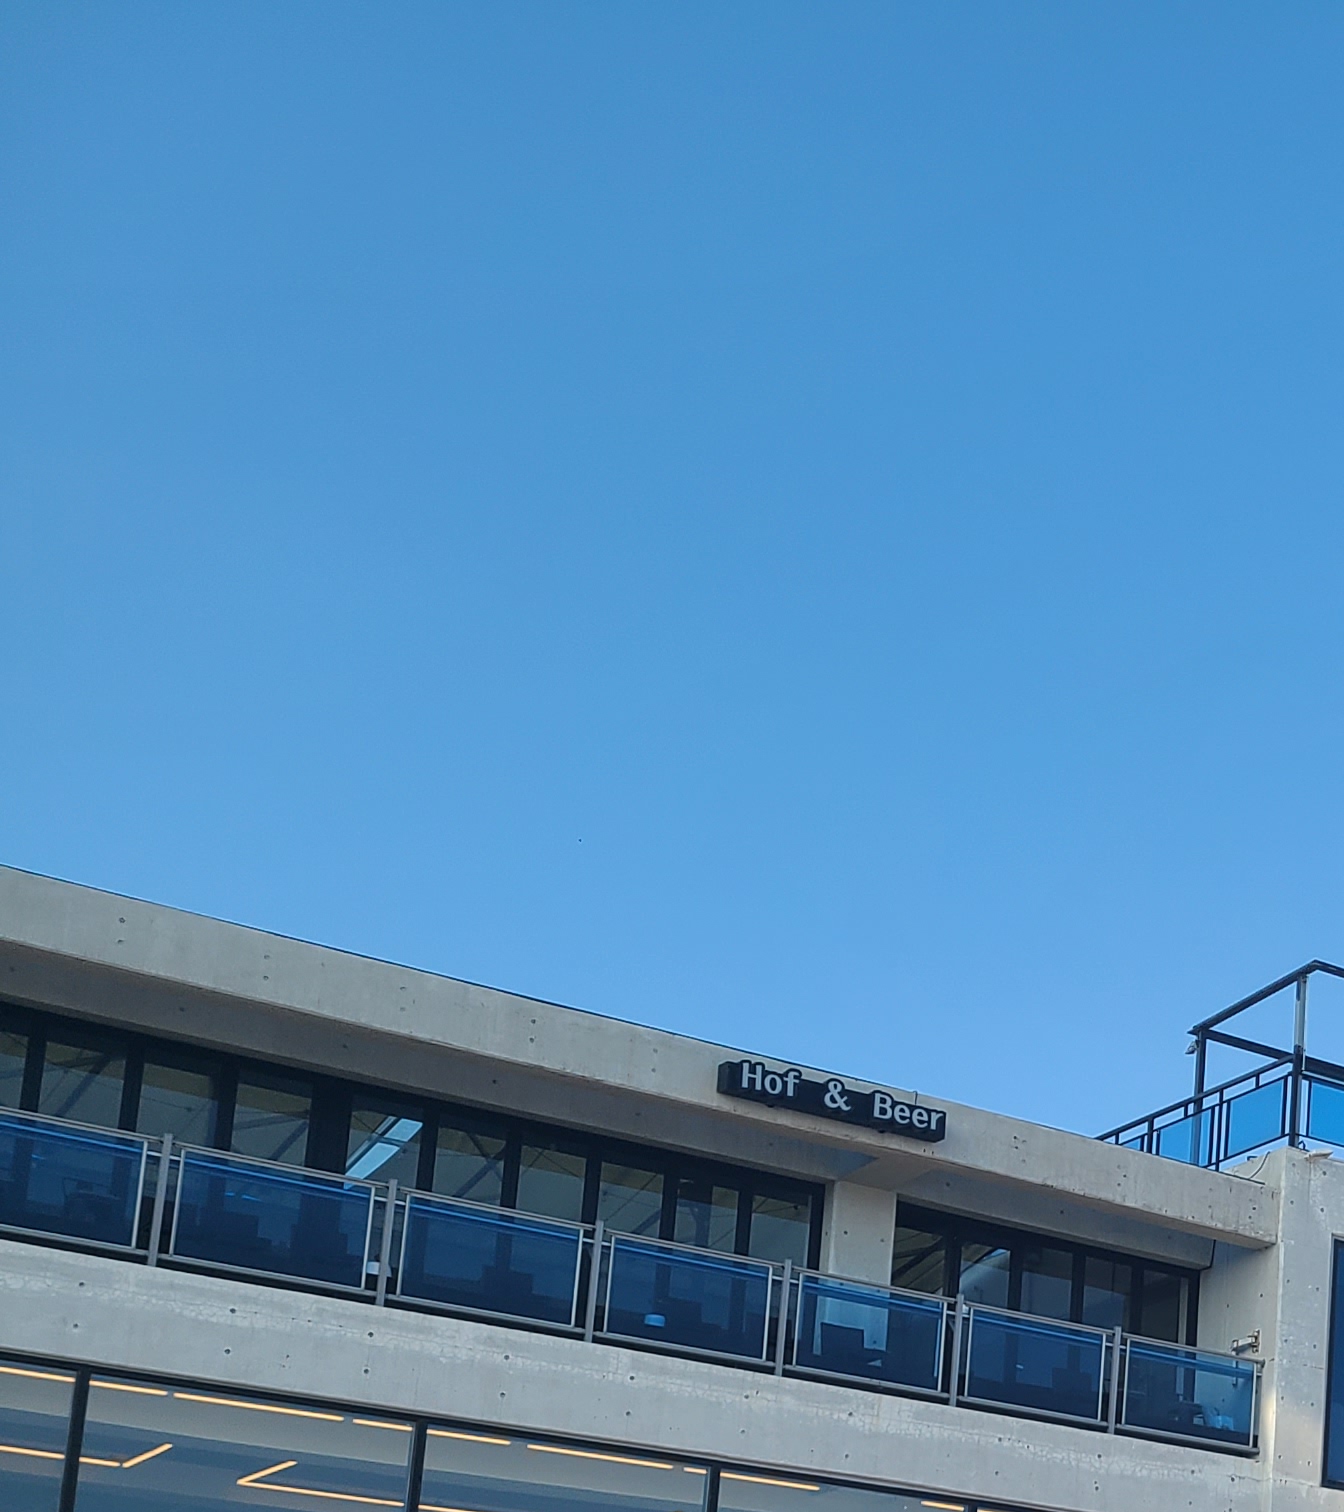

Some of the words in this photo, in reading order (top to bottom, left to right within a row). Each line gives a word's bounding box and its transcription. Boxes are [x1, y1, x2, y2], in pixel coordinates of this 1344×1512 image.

[741, 1062, 800, 1097] Hof
[823, 1079, 851, 1111] &
[872, 1092, 944, 1131] Beer
